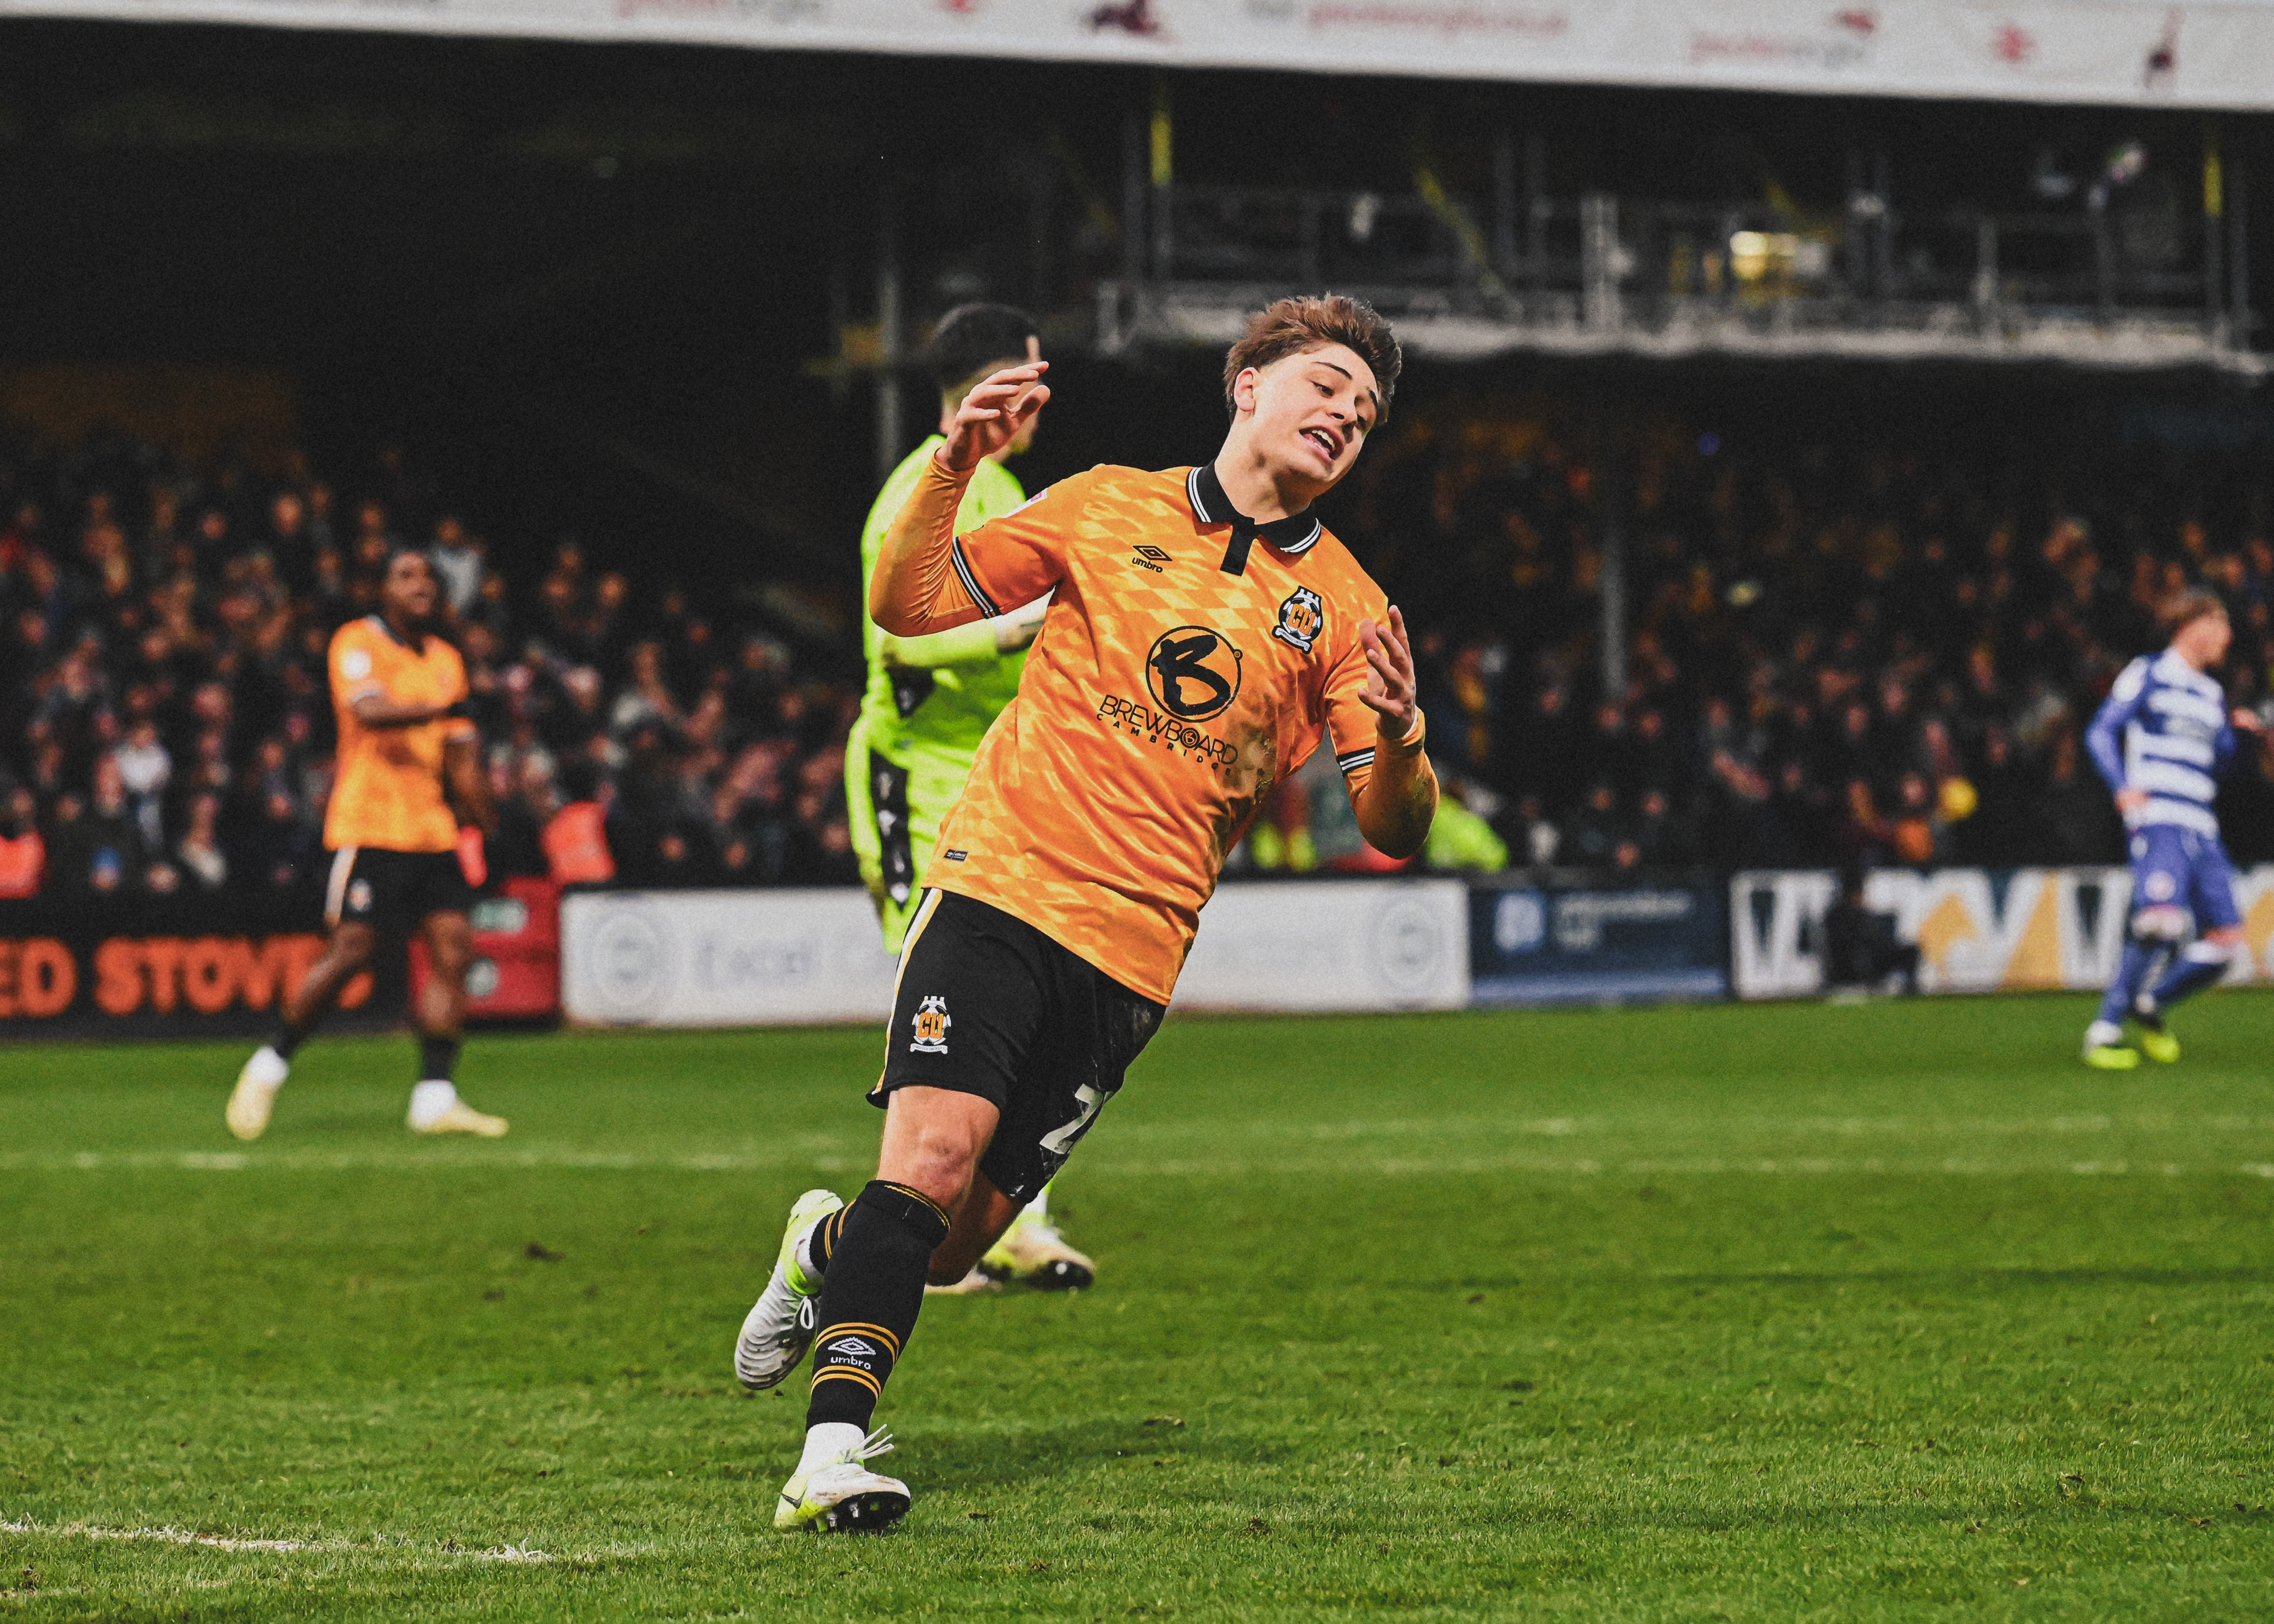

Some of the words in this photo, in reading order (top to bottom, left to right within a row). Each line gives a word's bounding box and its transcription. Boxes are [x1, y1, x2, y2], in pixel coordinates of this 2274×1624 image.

[1132, 558, 1163, 573] umbro
[1288, 603, 1316, 635] CU
[1096, 713, 1232, 776] CAMBRIDGE
[1099, 694, 1238, 765] BREWBOARD
[93, 931, 375, 1017] STOVE
[918, 1012, 944, 1039] CU
[831, 1356, 871, 1370] umbro
